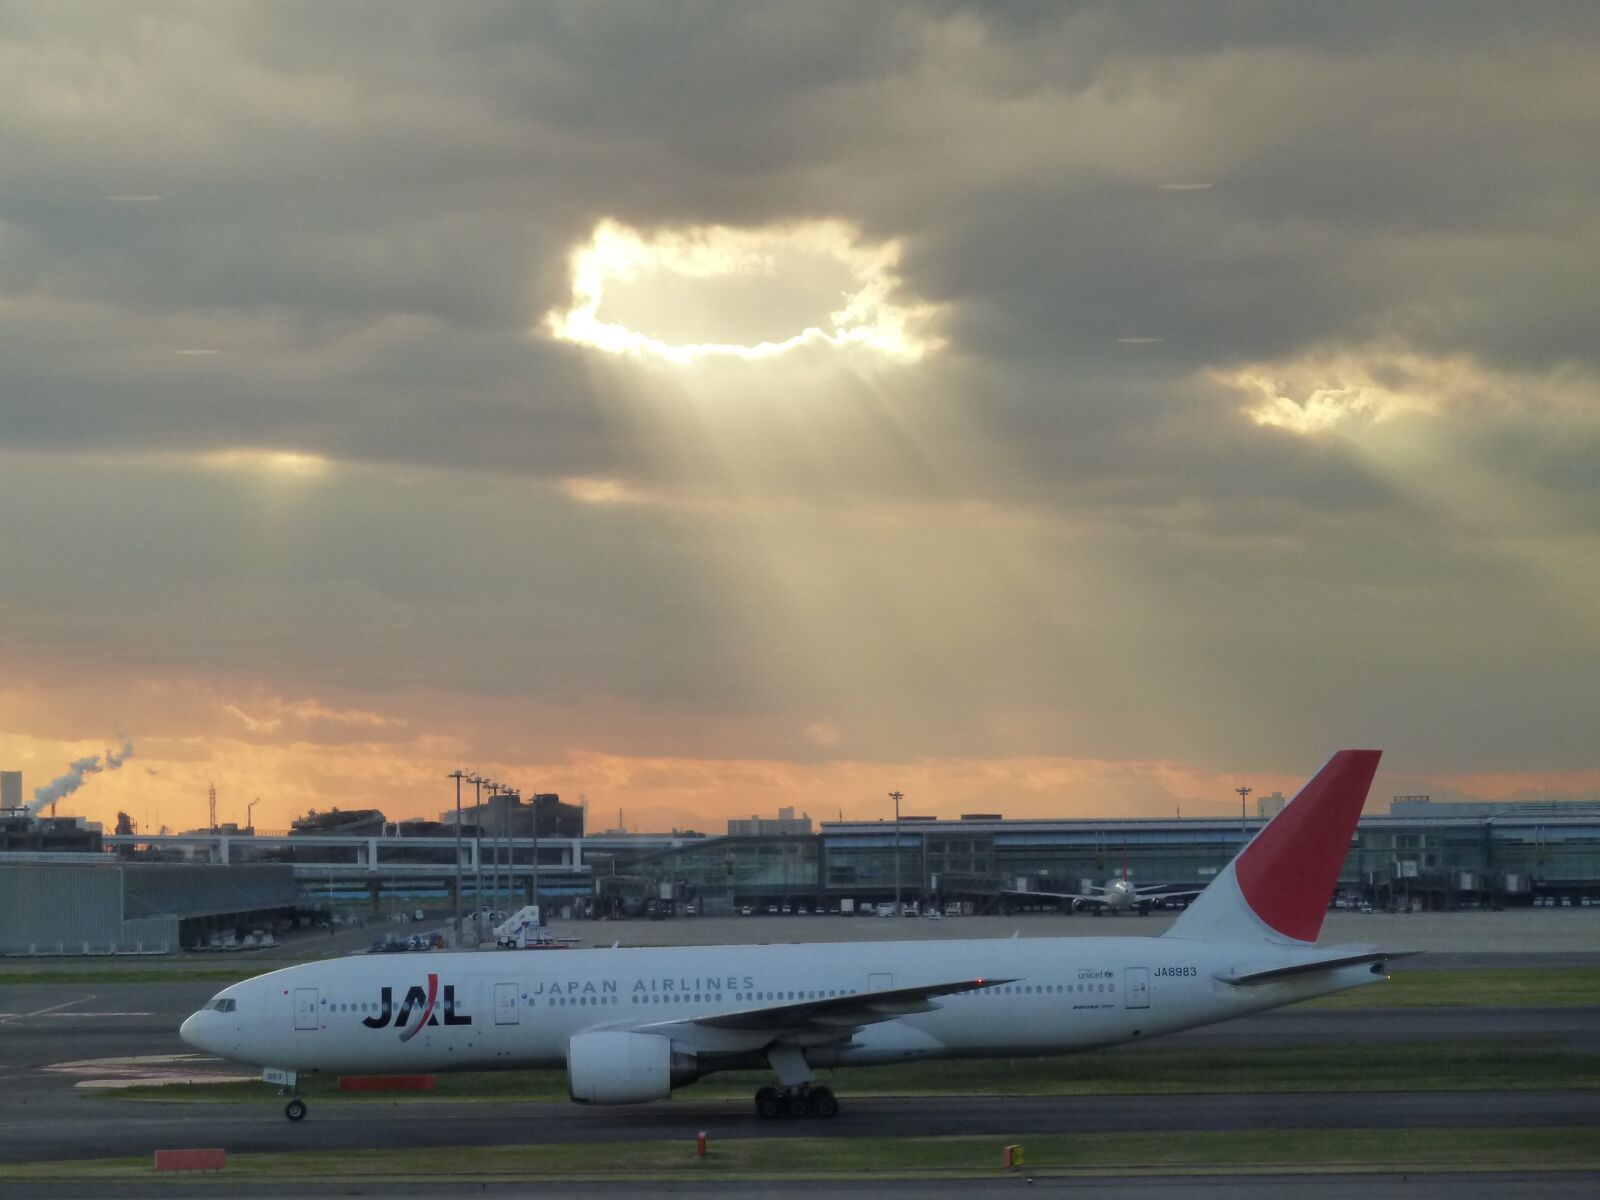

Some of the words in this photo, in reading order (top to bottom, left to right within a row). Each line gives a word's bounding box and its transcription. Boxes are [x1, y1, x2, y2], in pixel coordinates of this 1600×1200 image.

[1078, 970, 1104, 979] unicef
[1154, 967, 1197, 977] JA8983
[535, 980, 617, 995] JAPAN
[633, 976, 754, 992] AIRLINES
[362, 973, 472, 1043] JAL
